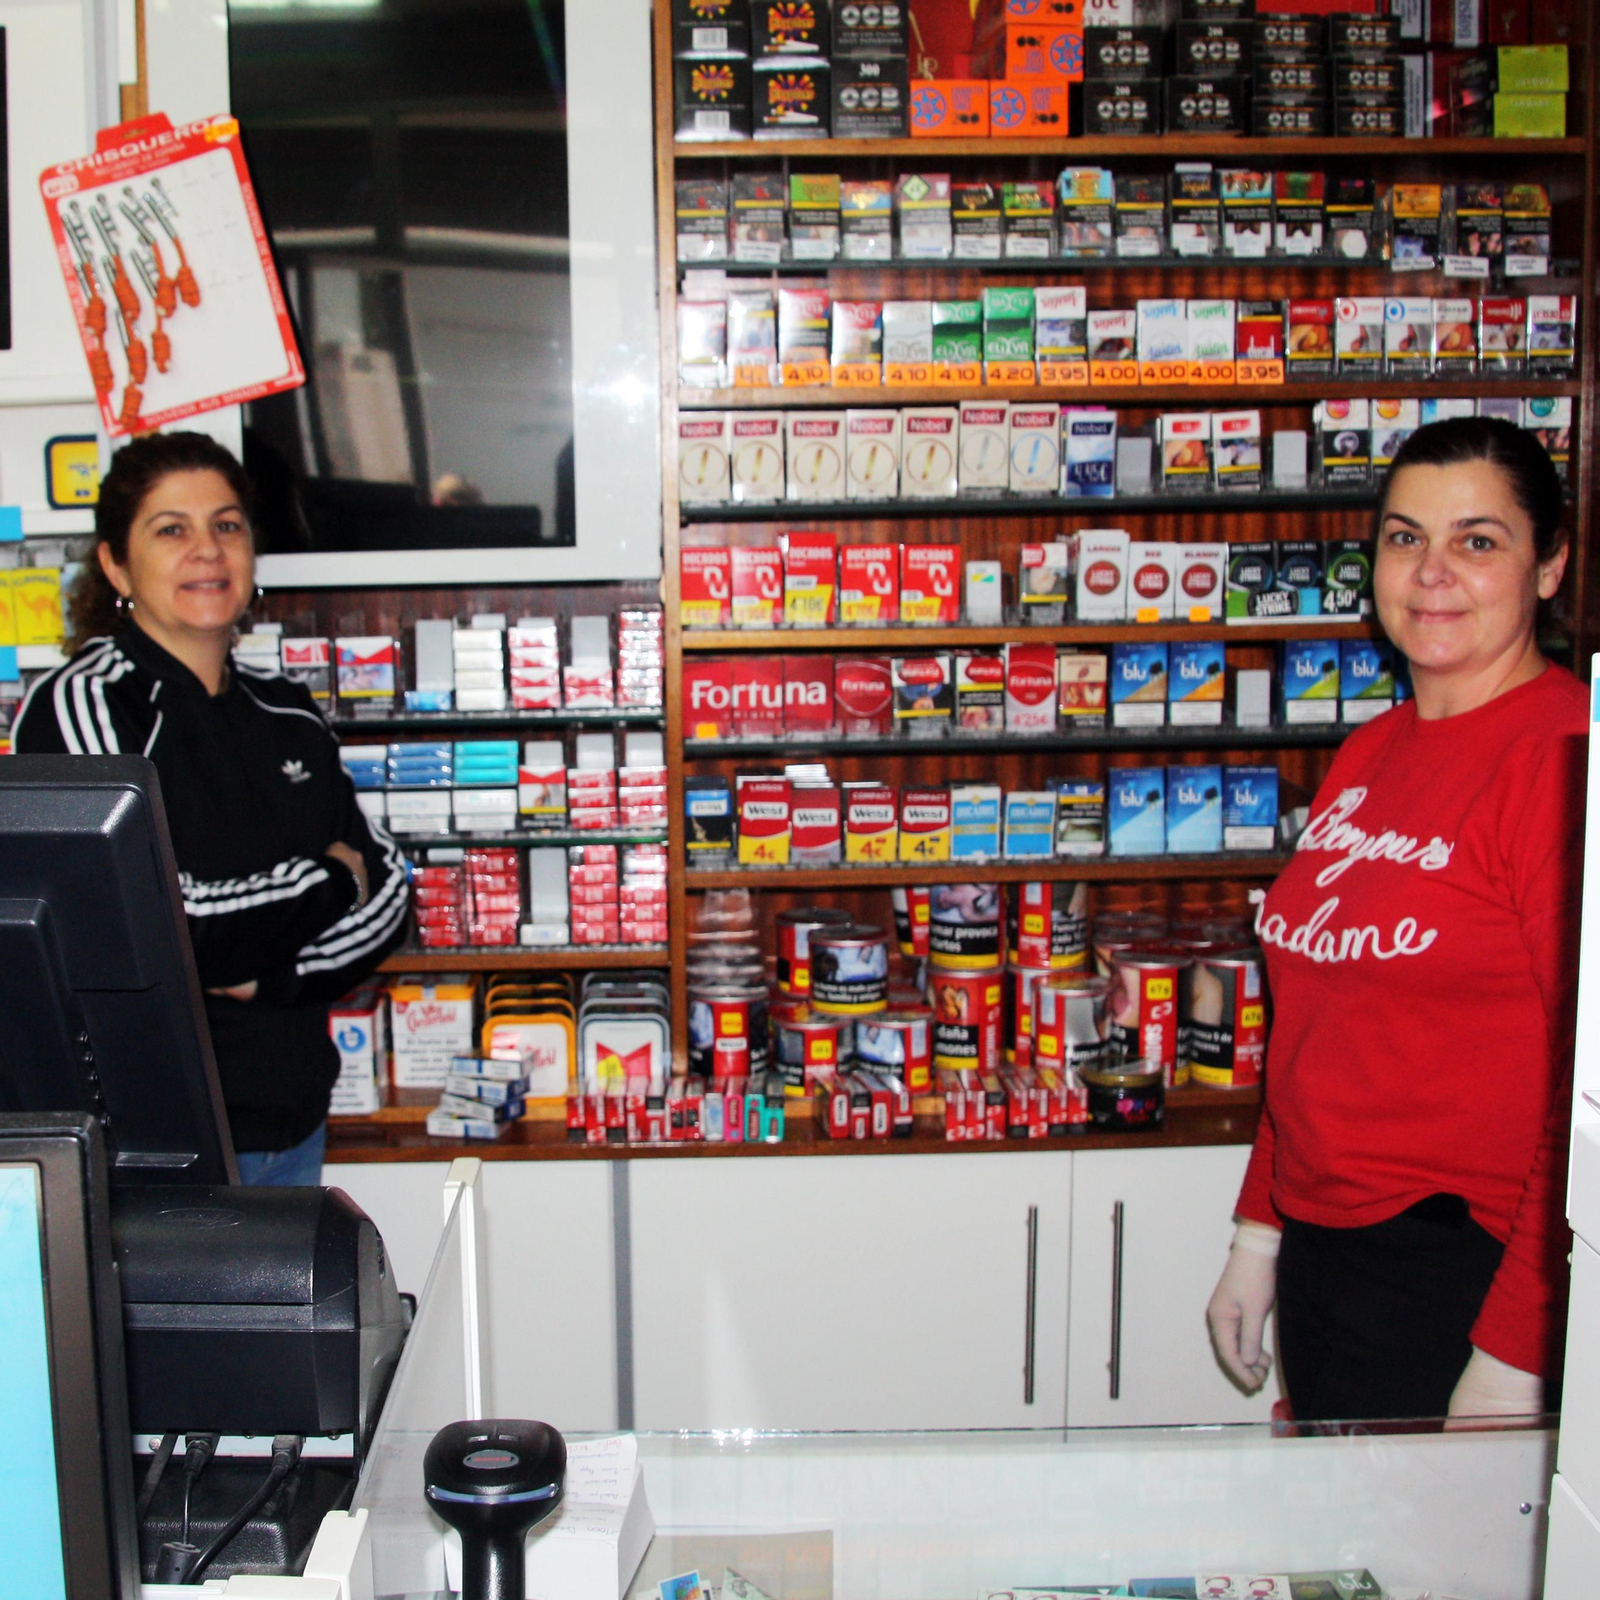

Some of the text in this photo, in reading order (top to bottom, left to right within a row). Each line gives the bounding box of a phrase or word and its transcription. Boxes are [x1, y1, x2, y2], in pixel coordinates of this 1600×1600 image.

[841, 5, 901, 26] OCB
[1264, 26, 1306, 43] OCB
[1346, 26, 1388, 43] OCB
[1099, 44, 1150, 65] OCB
[1190, 41, 1241, 60] OCB
[1270, 69, 1312, 86] OCB
[1349, 70, 1390, 87] OCB
[840, 87, 901, 109] OCB
[1097, 101, 1148, 119] OCB
[1180, 98, 1231, 117] OCB
[1268, 111, 1310, 128] OCB
[1351, 111, 1392, 128] OCB
[966, 410, 1000, 422] Nobel
[1015, 413, 1050, 427] Nobel
[683, 424, 719, 435] Nobel
[737, 423, 773, 435] Nobel
[796, 424, 833, 435] Nobel
[853, 420, 889, 432] Nobel
[910, 420, 947, 432] Nobel
[1074, 424, 1107, 434] Nobel
[1256, 592, 1290, 606] LUCKY
[1255, 602, 1292, 617] STRIKE
[1123, 664, 1147, 681] blu
[1180, 662, 1204, 680] blu
[1296, 660, 1319, 677] blu
[1353, 661, 1375, 678] blu
[691, 679, 827, 710] Fortuna
[841, 680, 886, 692] Fortuna
[1120, 789, 1144, 807] blu
[1178, 787, 1202, 805] blu
[1234, 787, 1258, 806] blu
[748, 804, 783, 815] West
[797, 812, 833, 822] West
[854, 808, 890, 819] West
[908, 808, 944, 819] West
[955, 925, 999, 940] provoca
[938, 1025, 969, 1041] daña
[1338, 1577, 1372, 1591] blu
